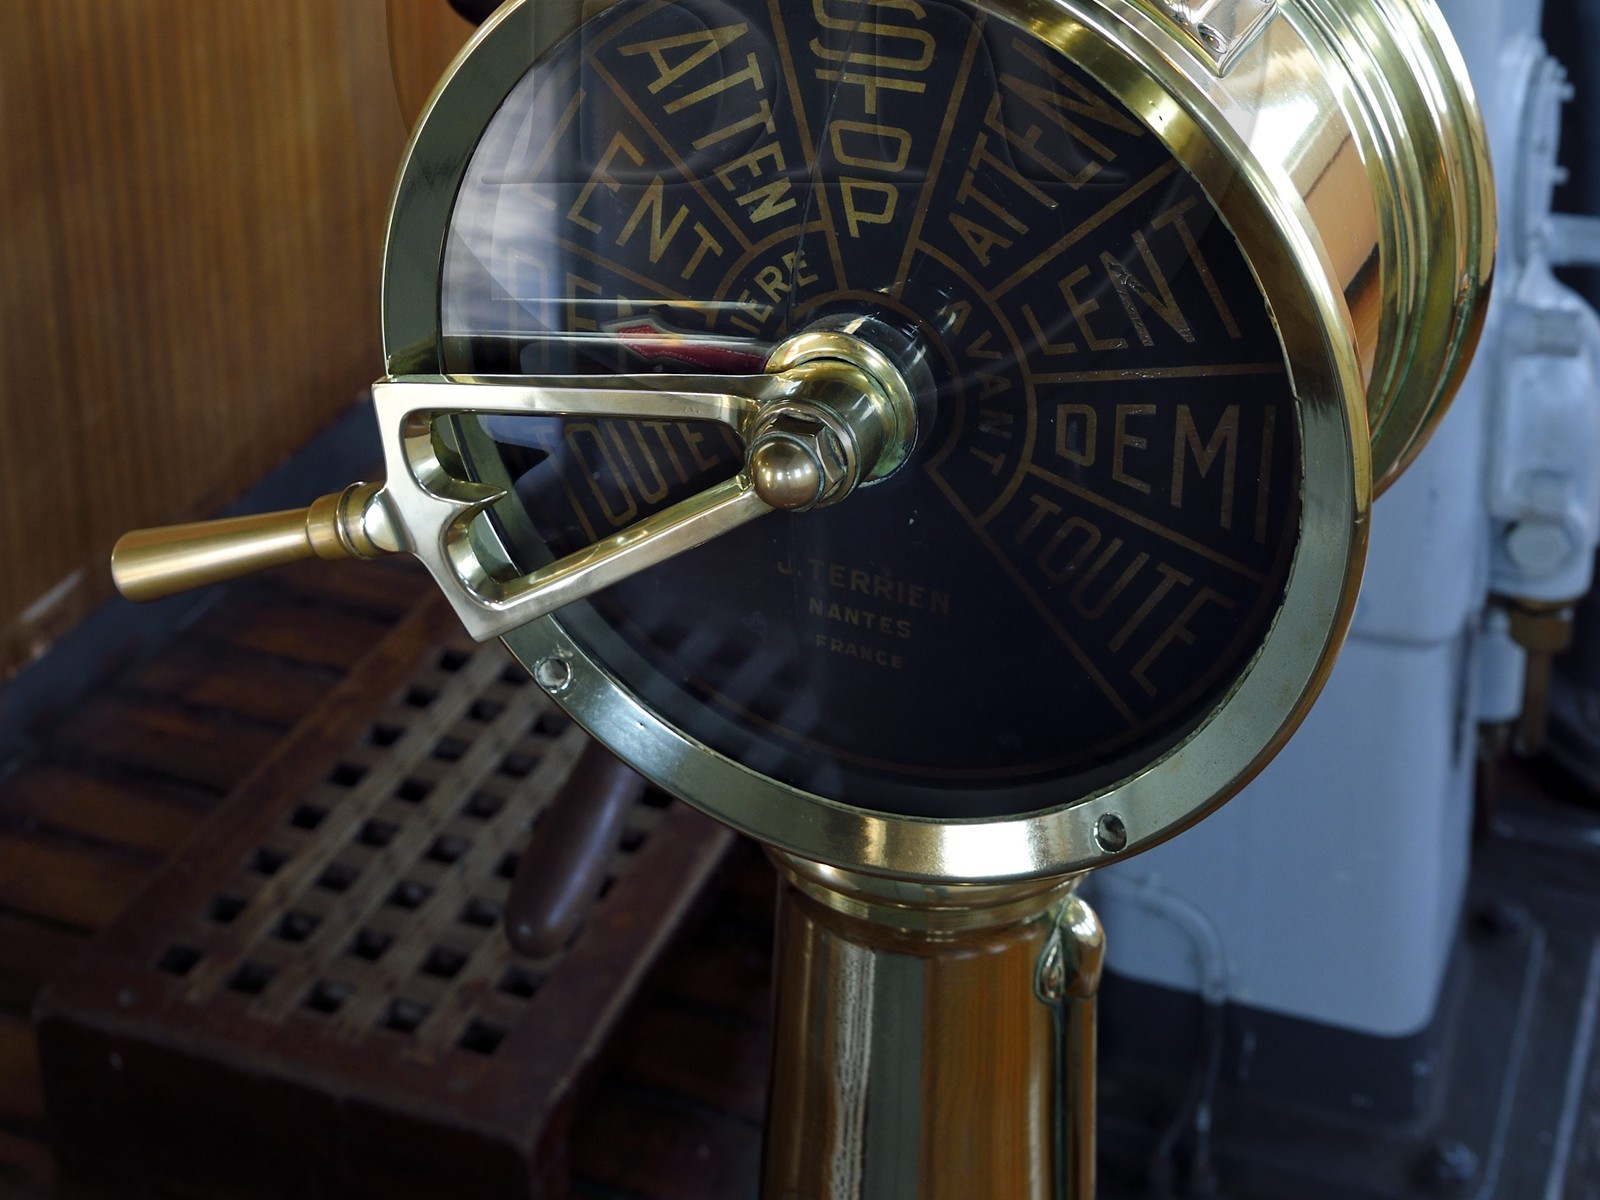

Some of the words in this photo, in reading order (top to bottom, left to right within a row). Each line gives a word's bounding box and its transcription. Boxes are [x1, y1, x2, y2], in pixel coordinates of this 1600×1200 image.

[618, 22, 798, 224] ATTEN
[948, 36, 1145, 267] ATTEN
[1021, 200, 1242, 356] LENT
[935, 299, 1015, 476] AVANT
[1056, 404, 1277, 545] DEMI
[808, 597, 912, 639] NANTES
[815, 634, 904, 669] FRANCE
[1014, 494, 1238, 698] TOUTE
